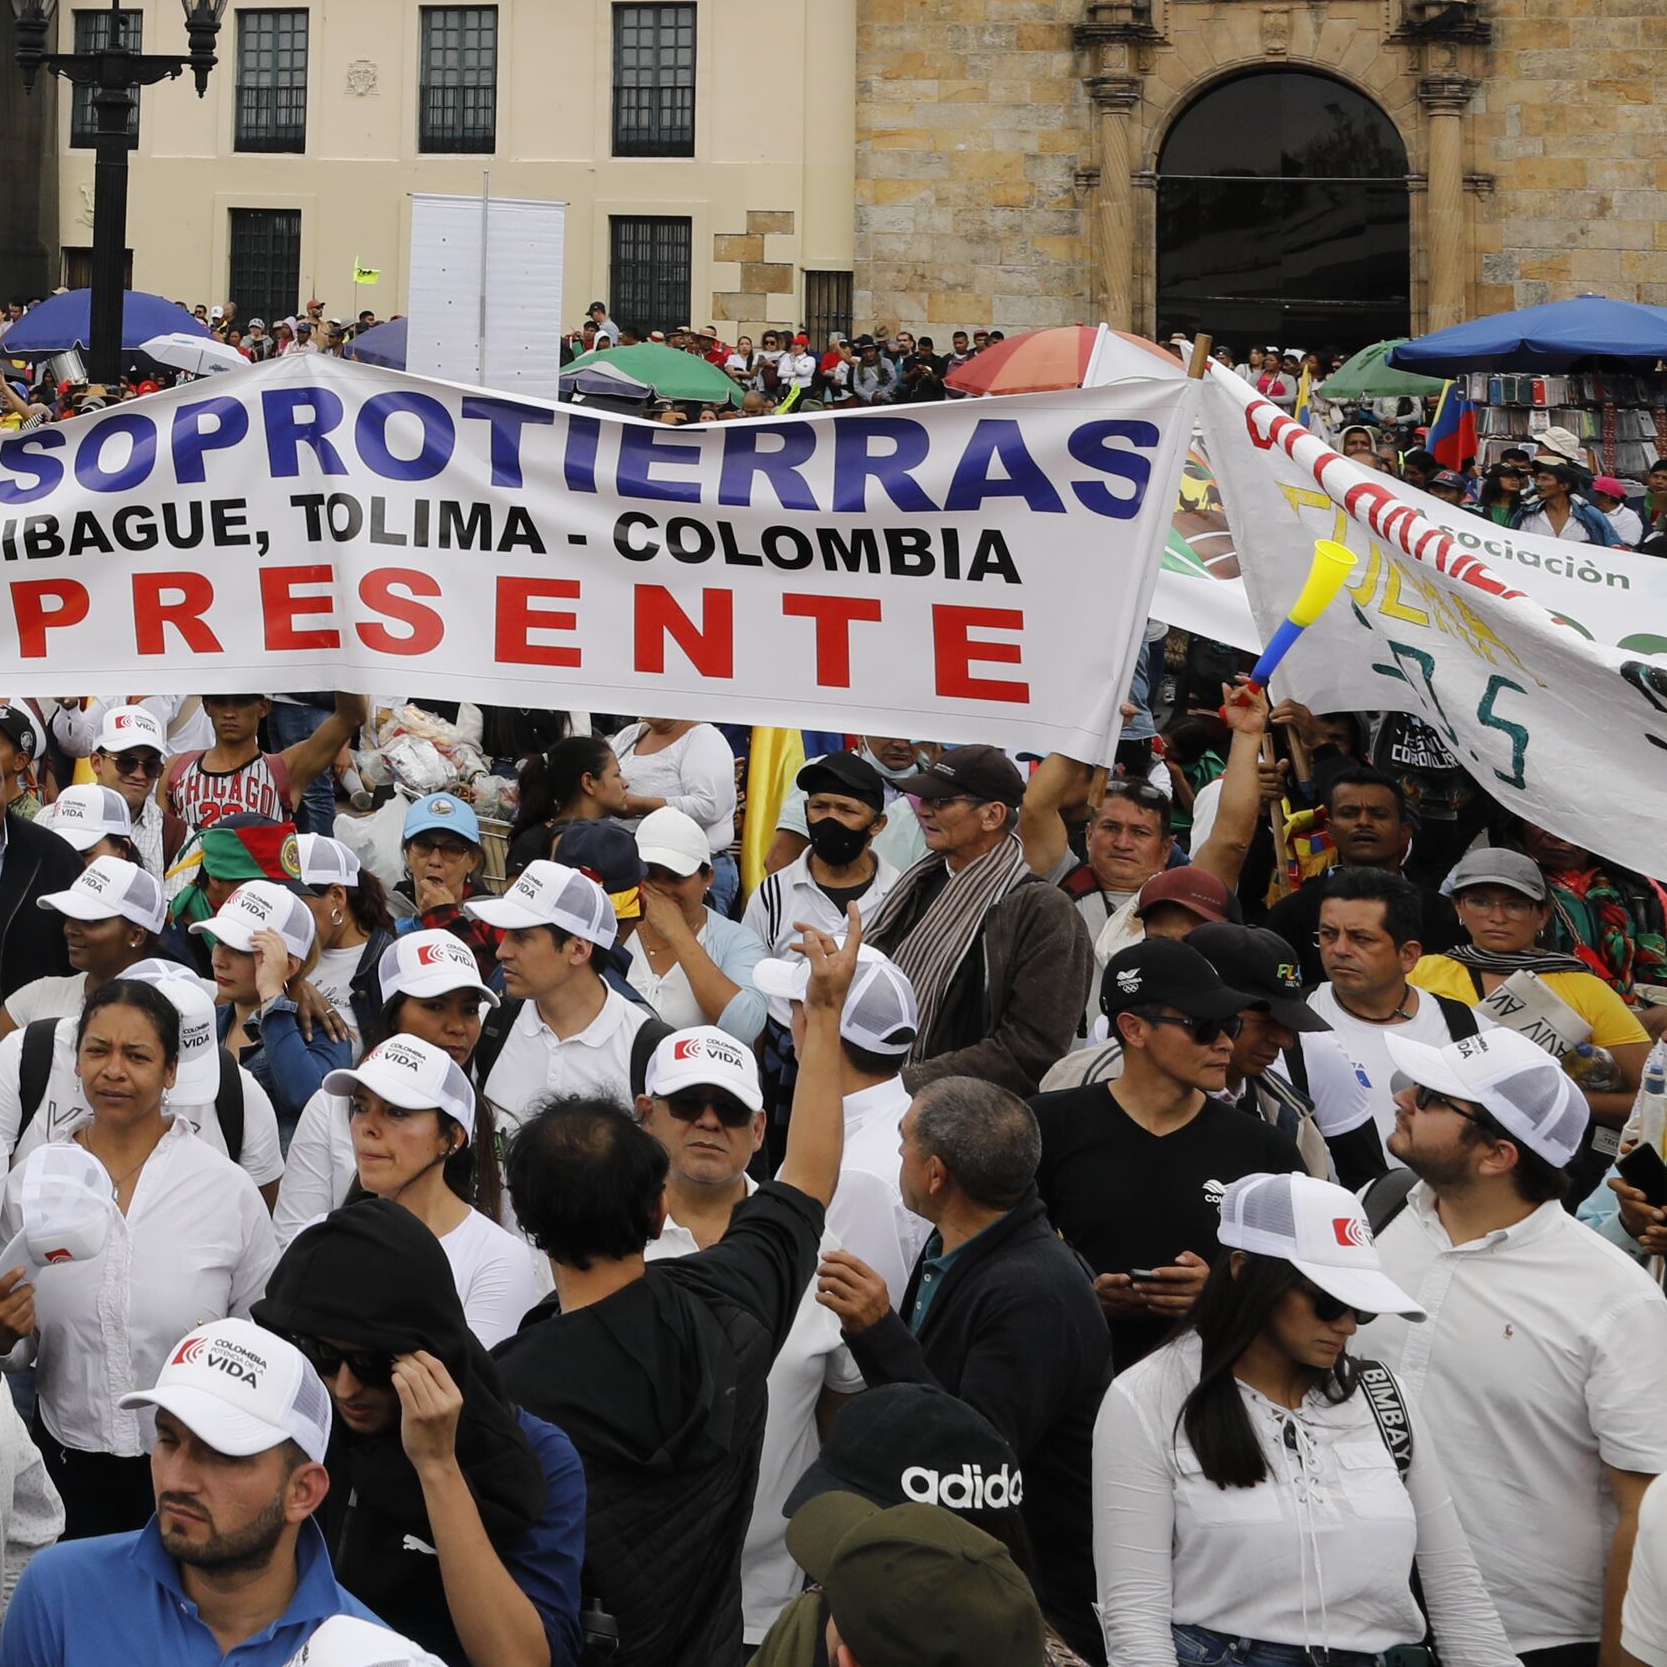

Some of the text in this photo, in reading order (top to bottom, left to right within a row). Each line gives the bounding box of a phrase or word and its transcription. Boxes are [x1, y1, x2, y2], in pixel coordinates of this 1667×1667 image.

[2, 496, 269, 561] IBAGUE,
[290, 492, 547, 555] TOLIMA
[612, 510, 1023, 586] COLOMBIA
[1416, 508, 1631, 590] sociaciòn
[9, 563, 1031, 705] PRESENTE
[171, 776, 274, 816] CHICAGO
[62, 809, 84, 819] VIDA
[81, 875, 103, 894] VIDA
[241, 899, 265, 921] VIDA
[182, 1033, 210, 1049] VIDA
[1457, 1042, 1473, 1059] DA
[384, 1052, 419, 1072] VIDA
[706, 1048, 744, 1070] VIDA
[210, 1346, 244, 1363] POTENCIA
[214, 1338, 267, 1369] COLOMBIA
[207, 1353, 257, 1389] VIDA
[901, 1464, 1023, 1509] adida
